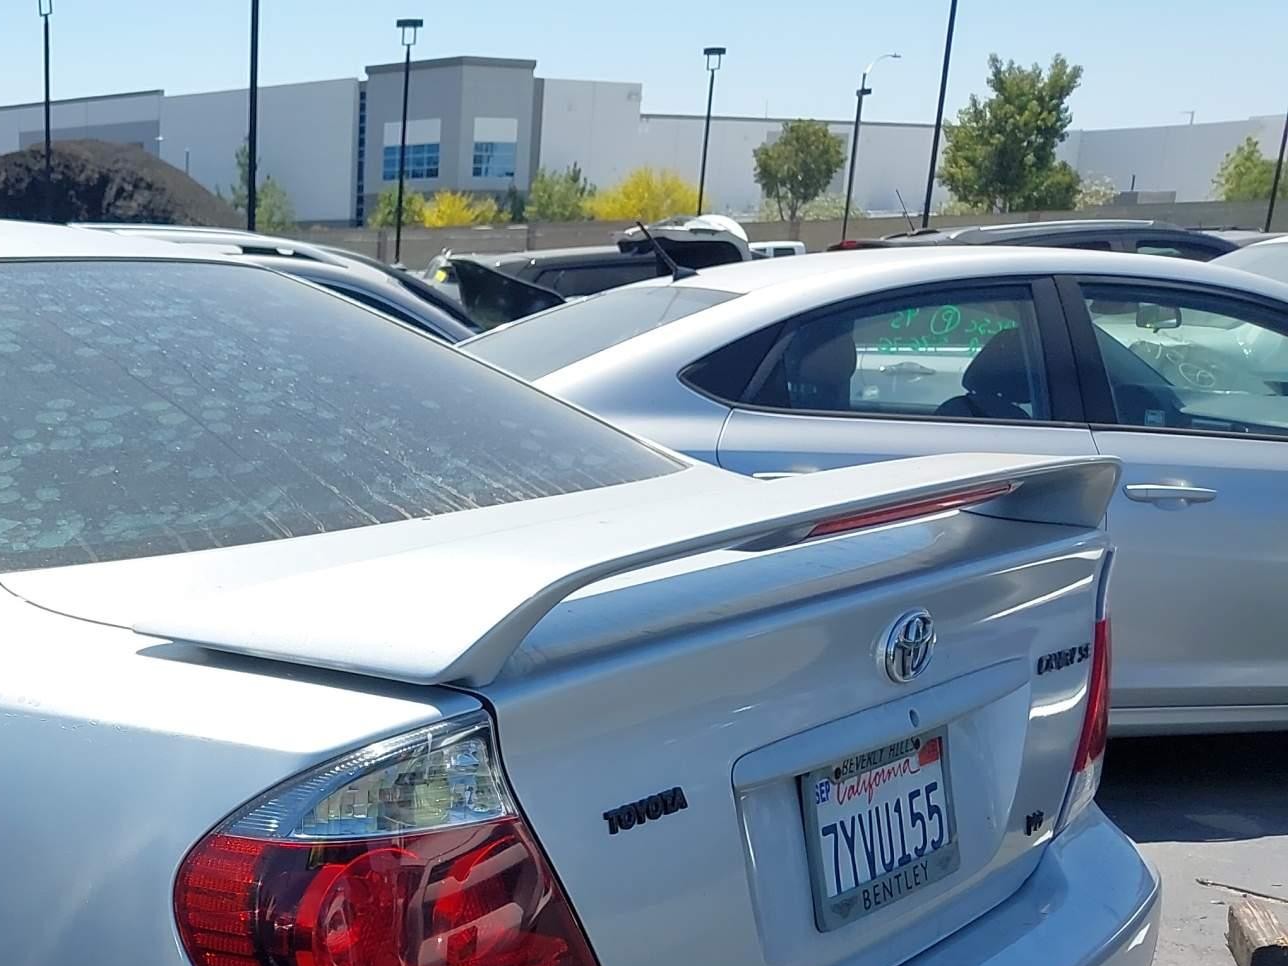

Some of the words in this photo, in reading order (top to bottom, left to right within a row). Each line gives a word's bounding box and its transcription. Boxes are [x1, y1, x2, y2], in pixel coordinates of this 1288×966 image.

[841, 748, 885, 776] BEVERLY
[888, 736, 916, 759] HILLS
[815, 780, 831, 805] SEP
[837, 758, 920, 805] California
[602, 785, 688, 836] TOYOTA
[821, 781, 944, 896] 7YVU155
[862, 860, 929, 910] BENTLEY
